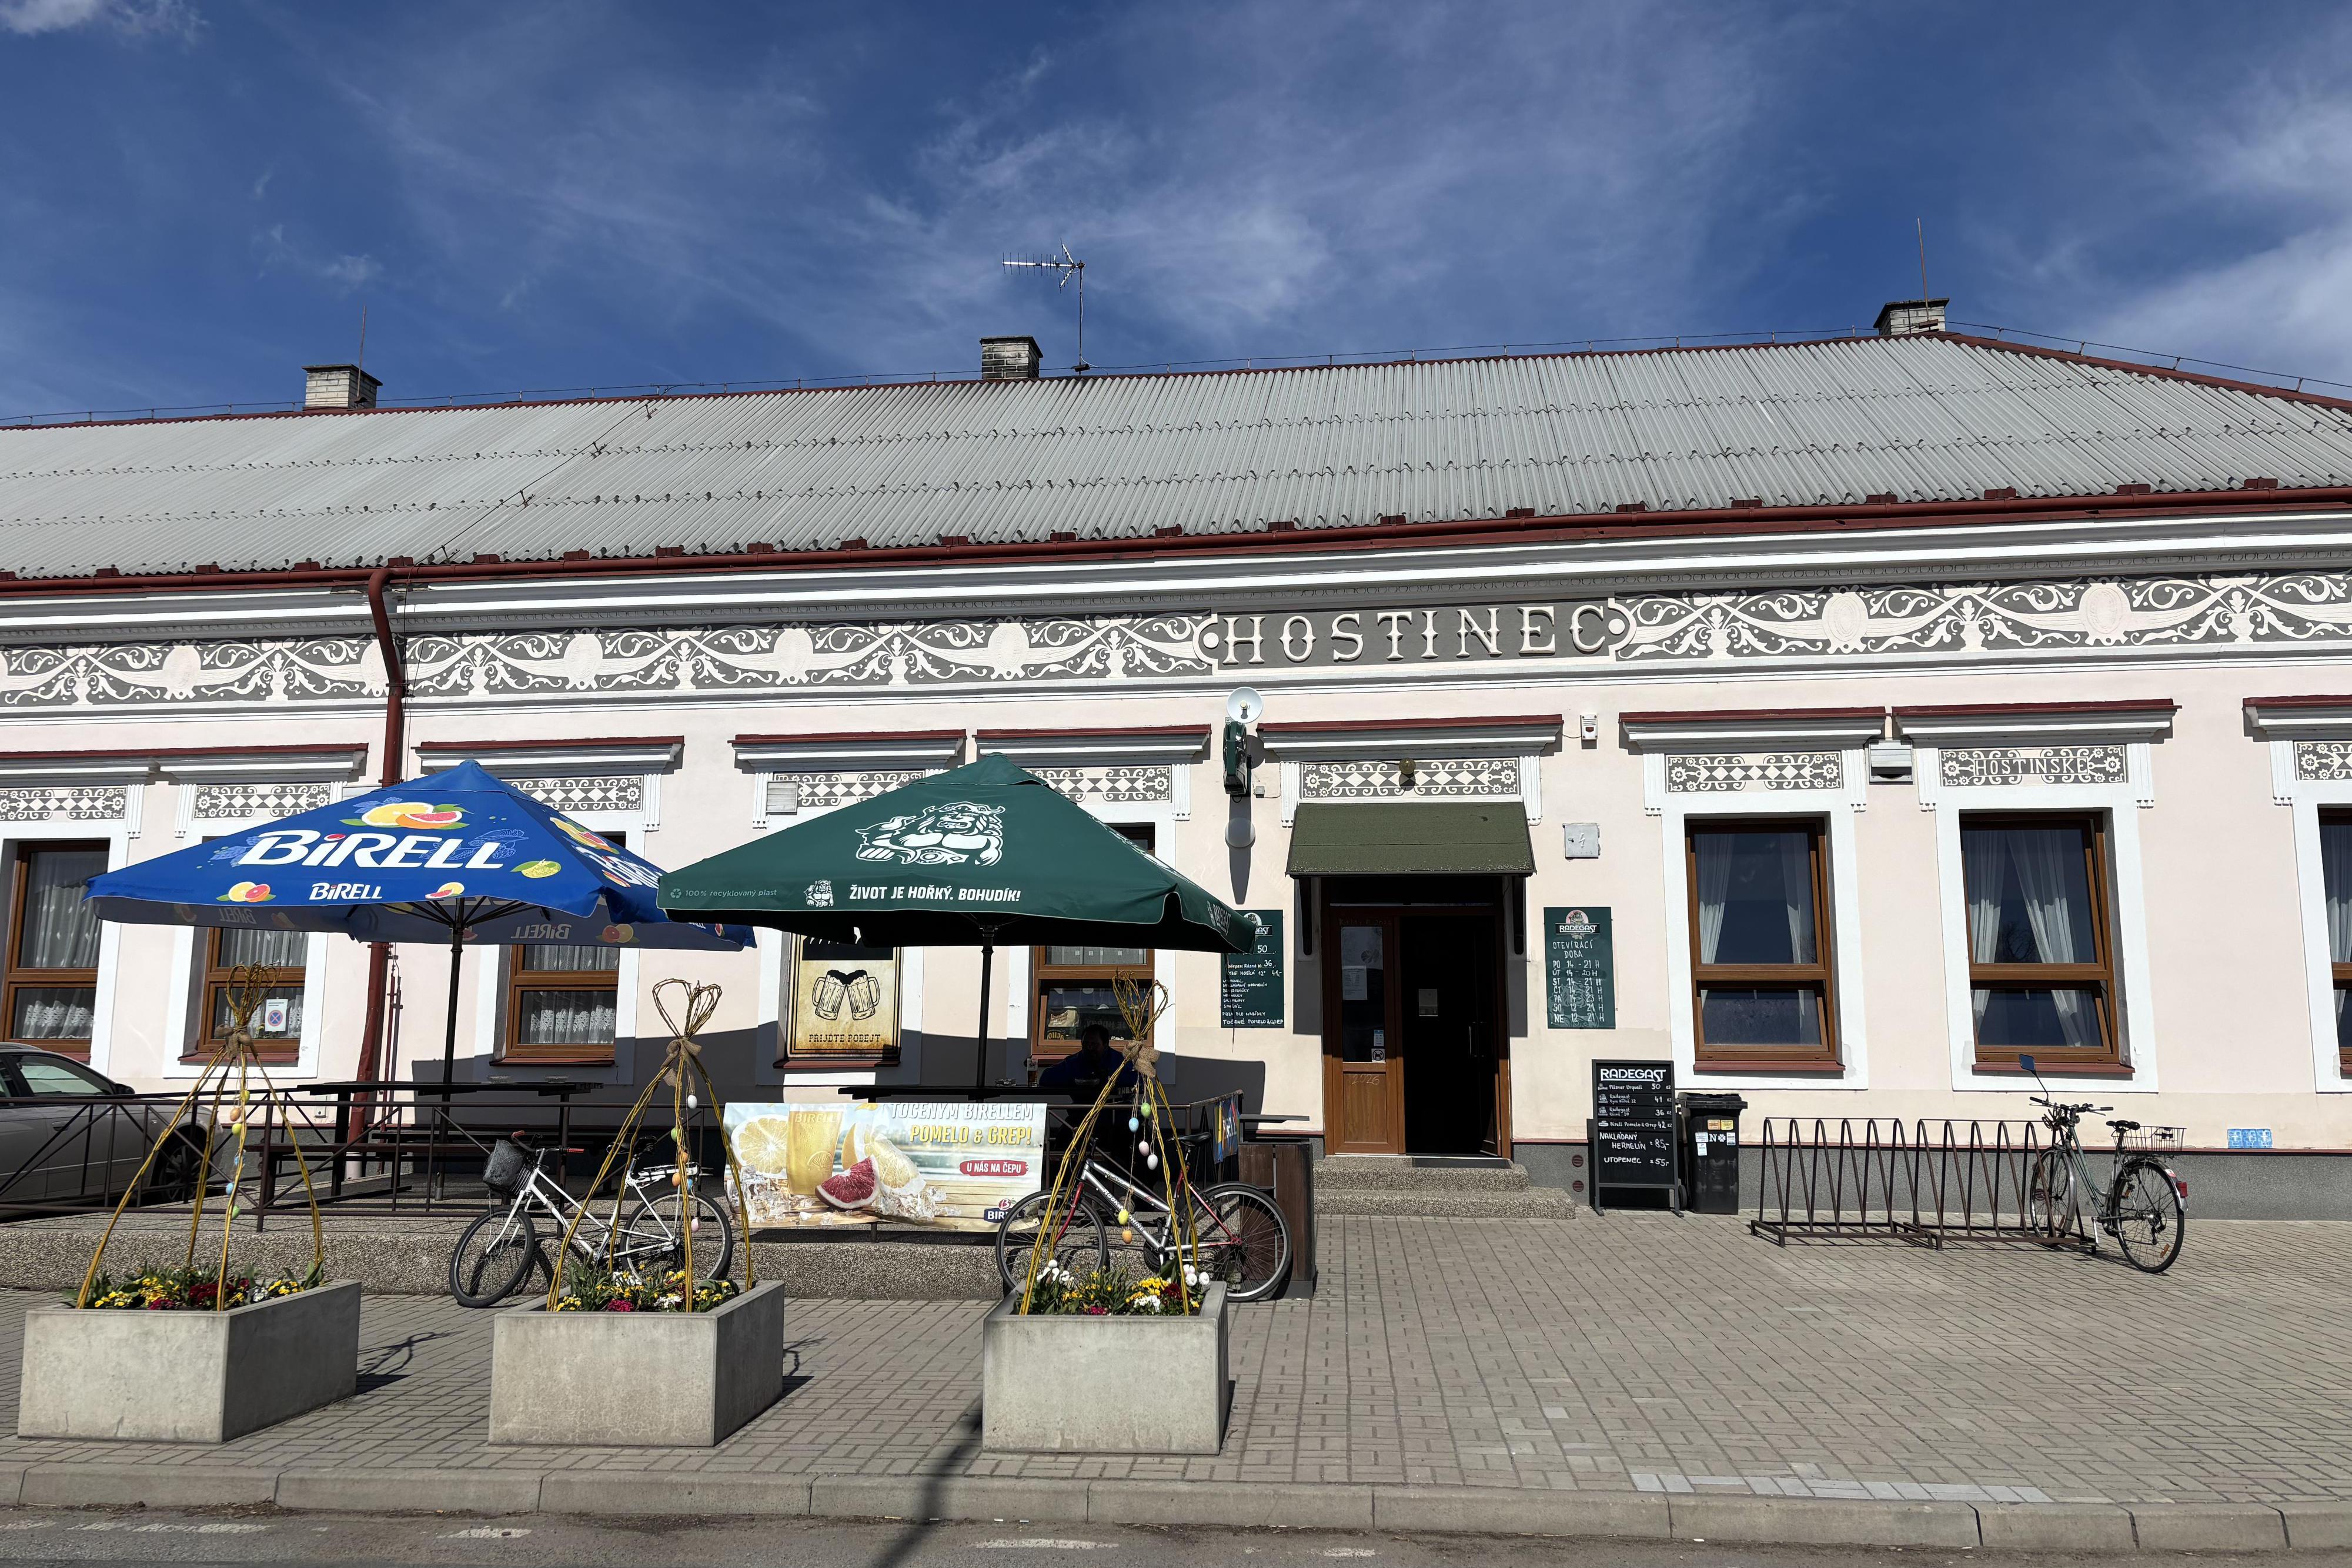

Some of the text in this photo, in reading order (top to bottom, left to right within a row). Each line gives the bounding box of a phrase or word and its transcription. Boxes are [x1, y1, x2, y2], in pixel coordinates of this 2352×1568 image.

[1222, 604, 1605, 665] HOSTINEC
[709, 888, 756, 899] recyklovaný
[758, 888, 777, 898] plast
[849, 882, 1021, 902] ŽIVOT JE HOŘKÝ. BOHUDÍK!
[1257, 945, 1268, 953] 50
[1553, 940, 1593, 950] OTEVÍRACÍ
[1564, 950, 1583, 959] DOBA
[1553, 960, 1560, 968] PO
[1583, 959, 1591, 968] 21
[1595, 959, 1599, 968] H
[1552, 978, 1561, 986] ST
[1566, 977, 1575, 986] 14
[1584, 977, 1592, 986] 21
[1553, 985, 1561, 994] ČT
[1568, 985, 1575, 994] 14
[1586, 986, 1593, 994] 21
[1569, 994, 1576, 1003] 14
[1586, 994, 1595, 1002] 23
[1598, 994, 1603, 1003] H
[1553, 1002, 1603, 1012] SO 12 21 H
[1553, 1012, 1605, 1023] NE 12 21 H
[847, 1034, 881, 1042] POBEJT
[1601, 1068, 1666, 1082] RADEGAST
[910, 1125, 1033, 1146] POMELO & GREP!
[1599, 1132, 1638, 1141] NAKLÁDANÝ
[1612, 1141, 1646, 1150] HERMELÍN
[967, 1161, 1021, 1174] U NÁS NA ČEPU
